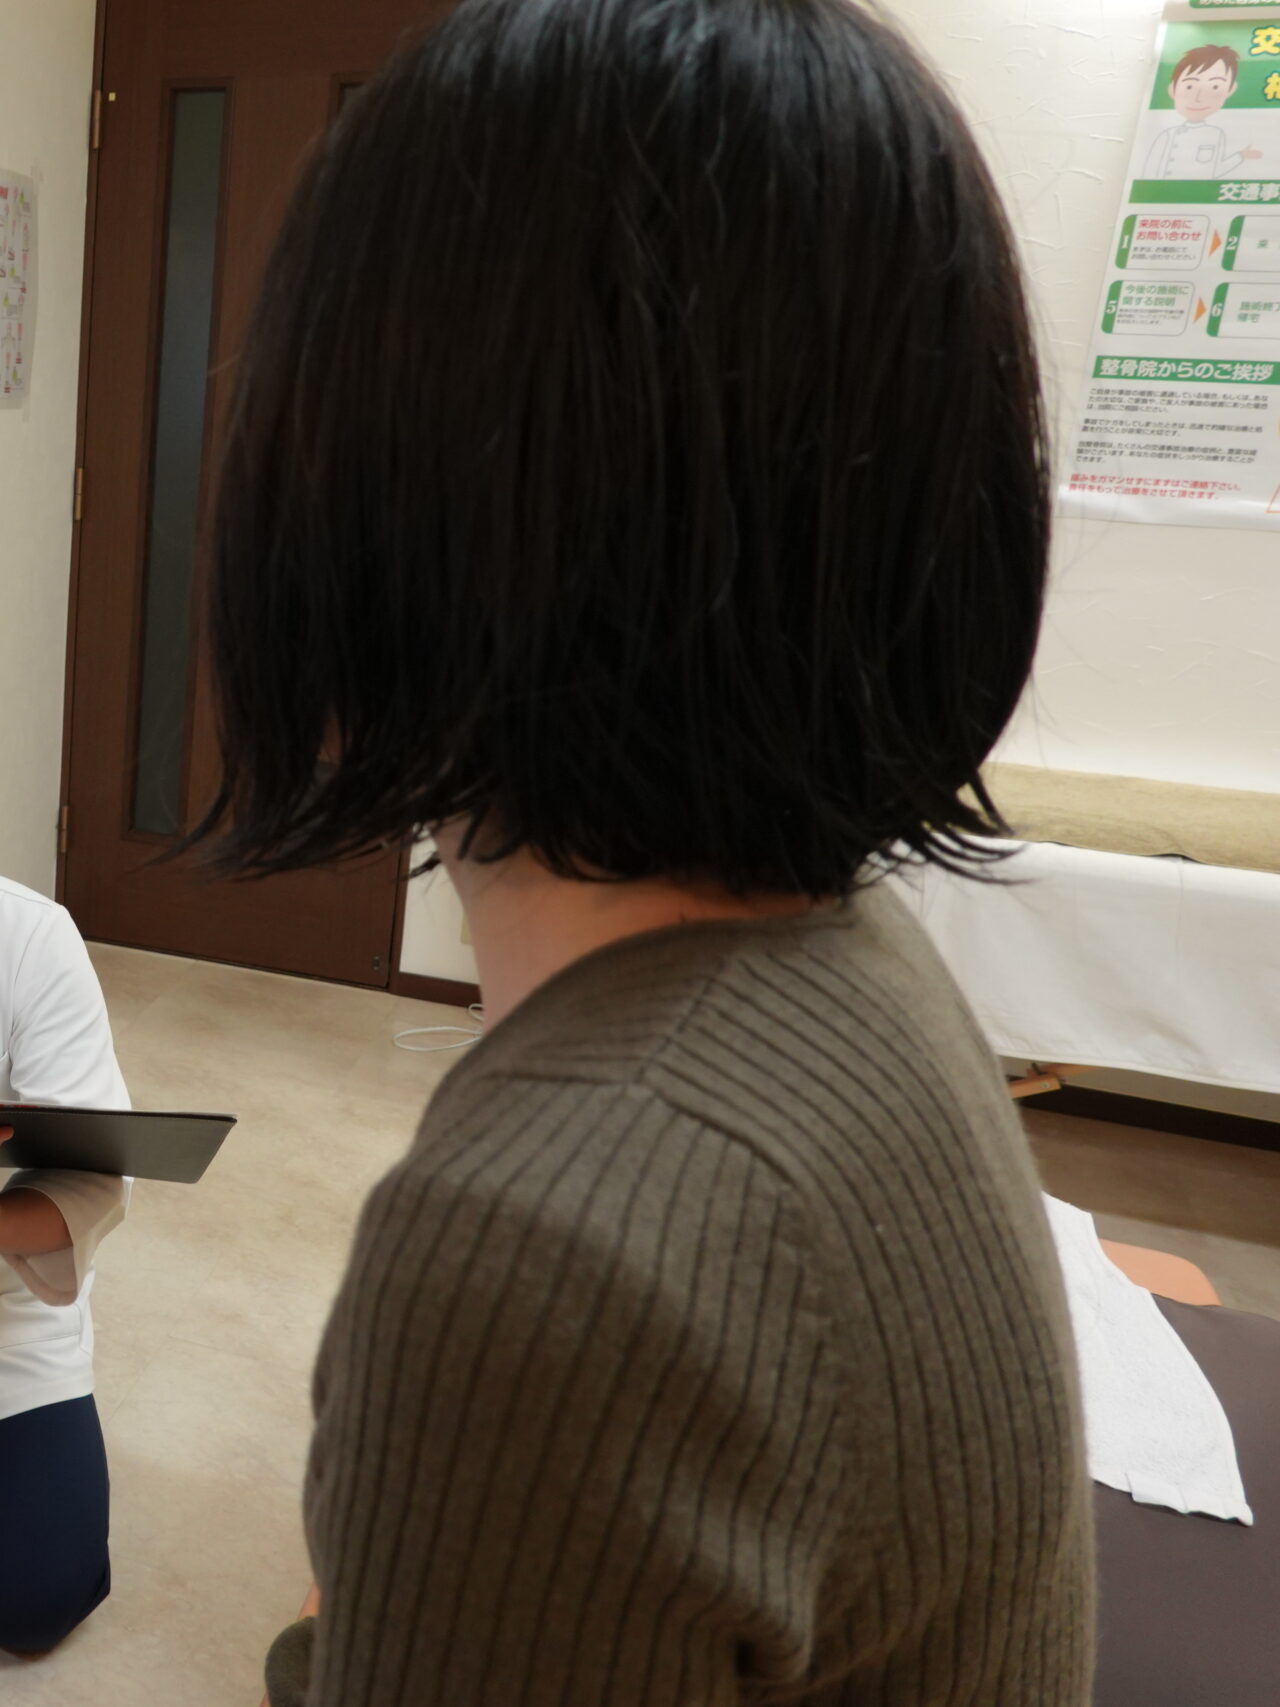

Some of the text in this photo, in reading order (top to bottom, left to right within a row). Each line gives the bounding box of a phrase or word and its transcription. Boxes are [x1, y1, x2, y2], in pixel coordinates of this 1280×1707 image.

[1121, 234, 1130, 250] 1
[1135, 231, 1202, 242] お問い合わせ
[1227, 236, 1239, 251] 2
[1106, 301, 1117, 315] 5
[1210, 304, 1222, 317] 6
[1099, 358, 1274, 382] 整骨院からのご挨拶
